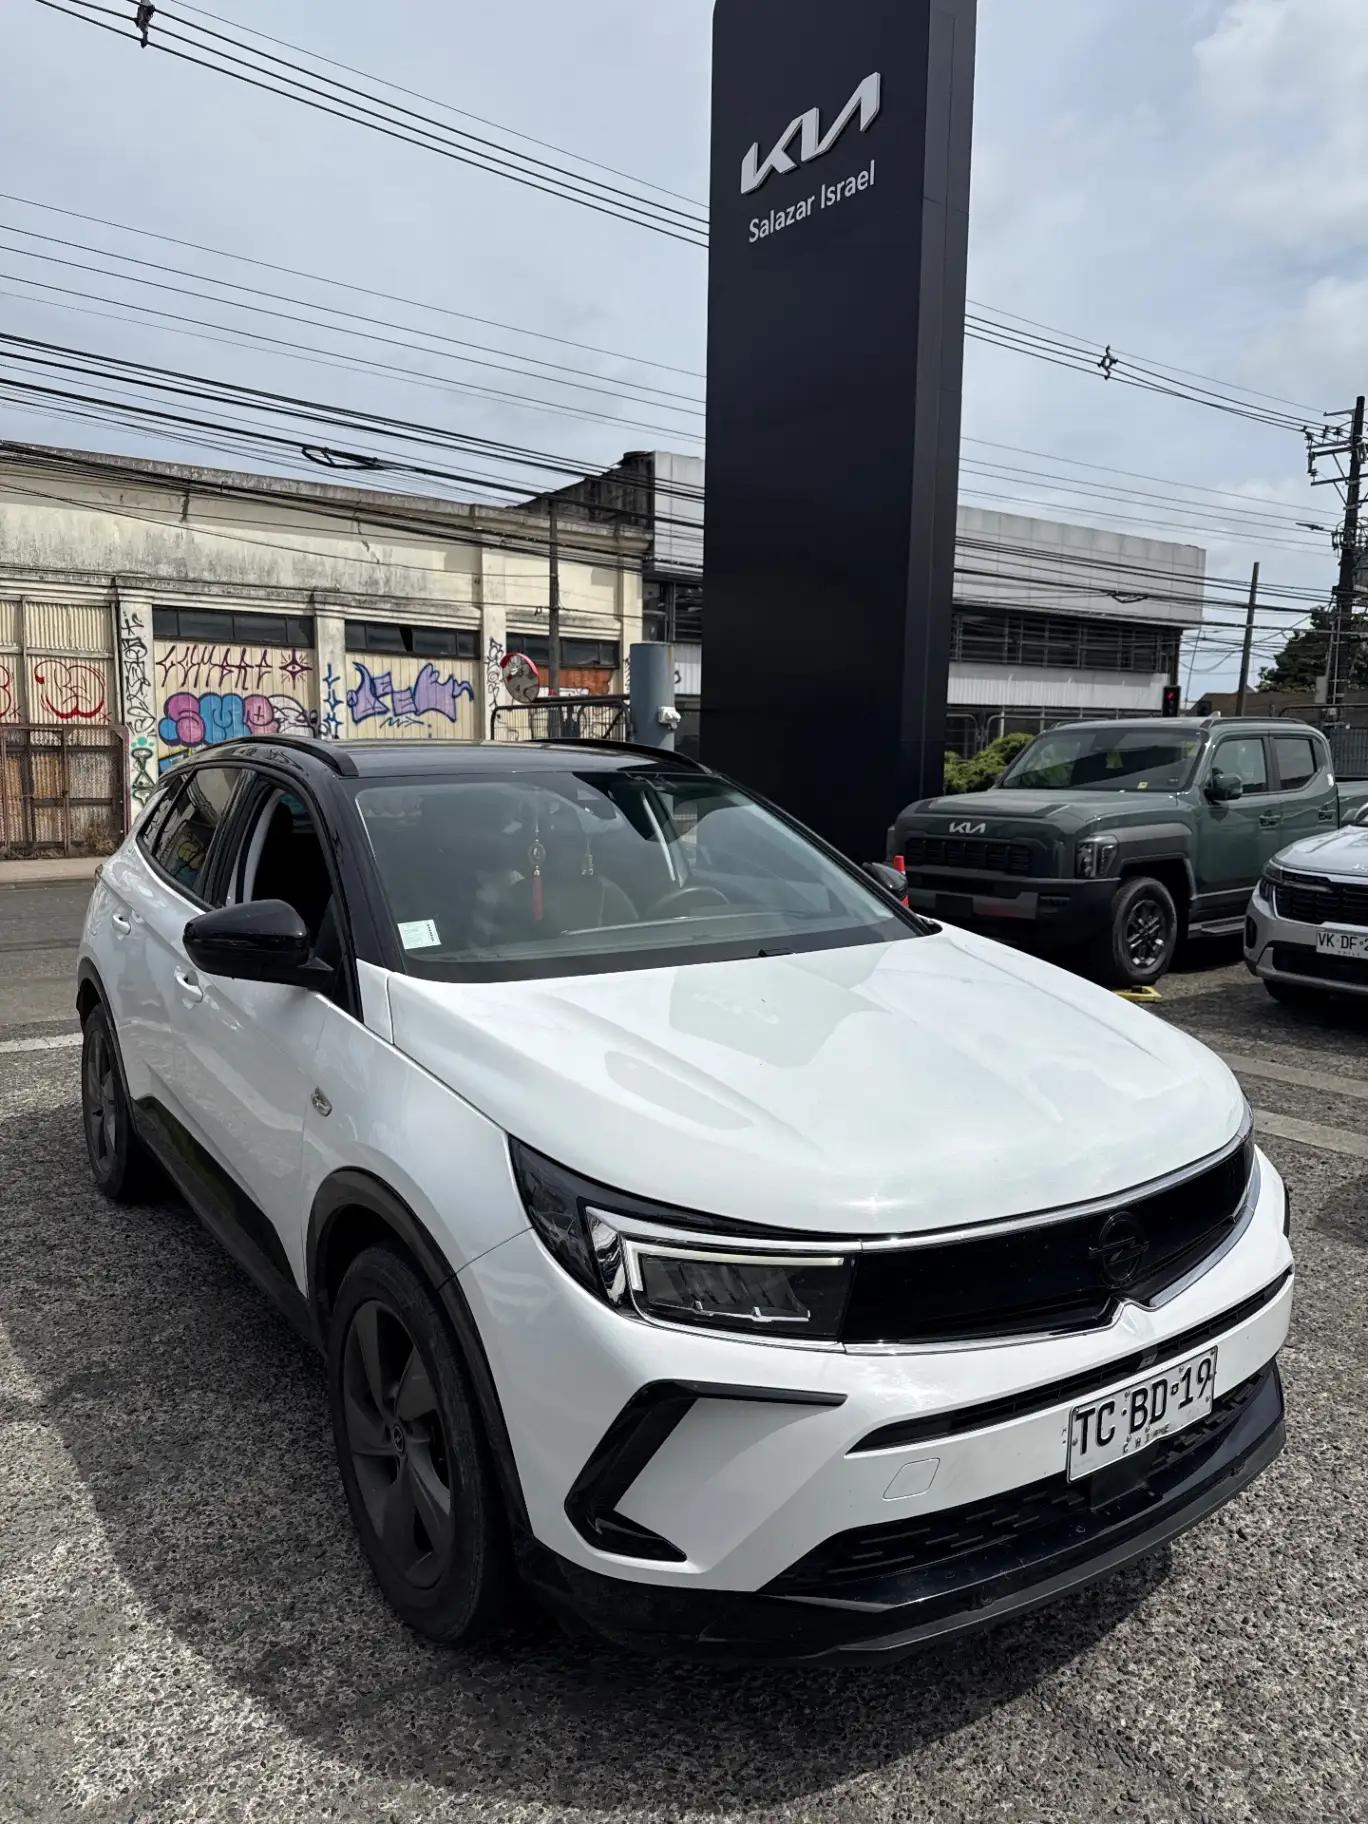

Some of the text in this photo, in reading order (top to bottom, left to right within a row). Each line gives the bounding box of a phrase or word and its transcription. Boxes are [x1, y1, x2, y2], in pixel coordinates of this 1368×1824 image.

[741, 71, 881, 194] KIA
[748, 159, 875, 243] Salazar Israel
[949, 821, 986, 834] KIA
